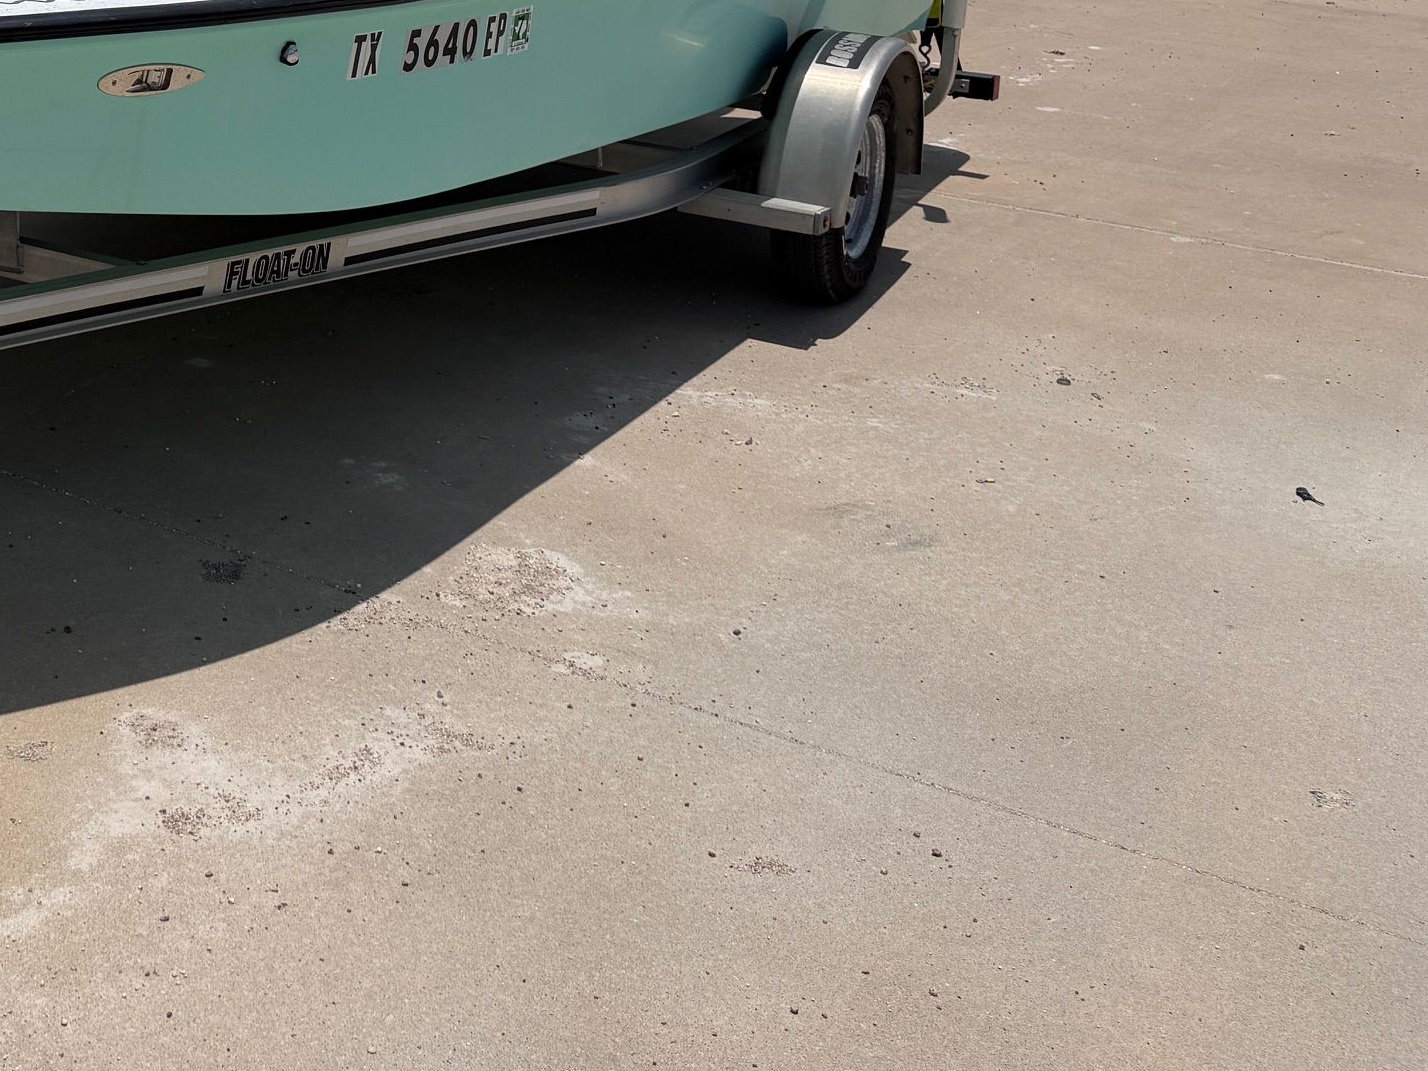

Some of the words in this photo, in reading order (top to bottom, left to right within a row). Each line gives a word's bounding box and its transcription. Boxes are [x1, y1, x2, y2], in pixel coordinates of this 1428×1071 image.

[351, 31, 383, 78] TX
[402, 18, 479, 72] 5640
[483, 12, 508, 57] EP
[222, 242, 332, 293] FLOAT-ON
